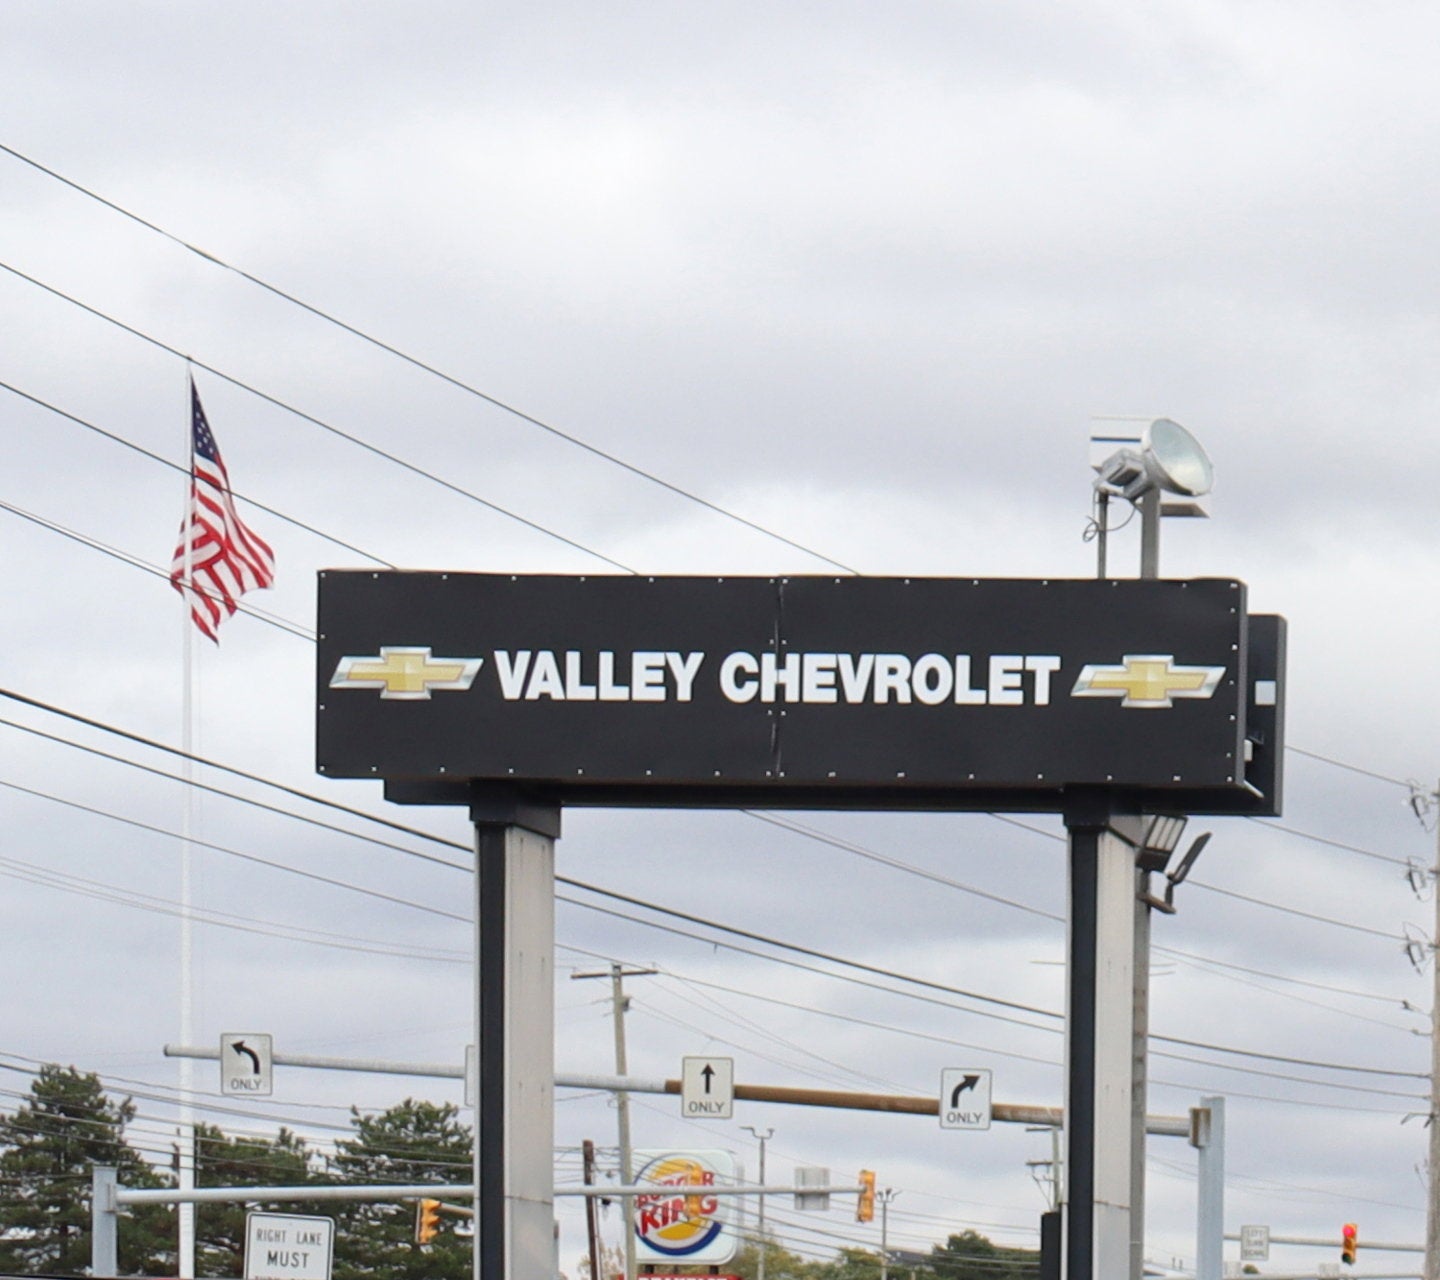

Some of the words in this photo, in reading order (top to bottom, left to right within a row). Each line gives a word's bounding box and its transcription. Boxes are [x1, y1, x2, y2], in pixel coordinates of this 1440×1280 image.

[494, 650, 705, 701] VALLEY
[720, 651, 1061, 705] CHEVROLET
[230, 1078, 262, 1091] ONLY
[688, 1101, 725, 1114] ONLY
[946, 1111, 984, 1125] ONLY
[256, 1228, 287, 1243] RIGHT
[296, 1231, 323, 1246] LANE
[267, 1250, 310, 1268] MUST
